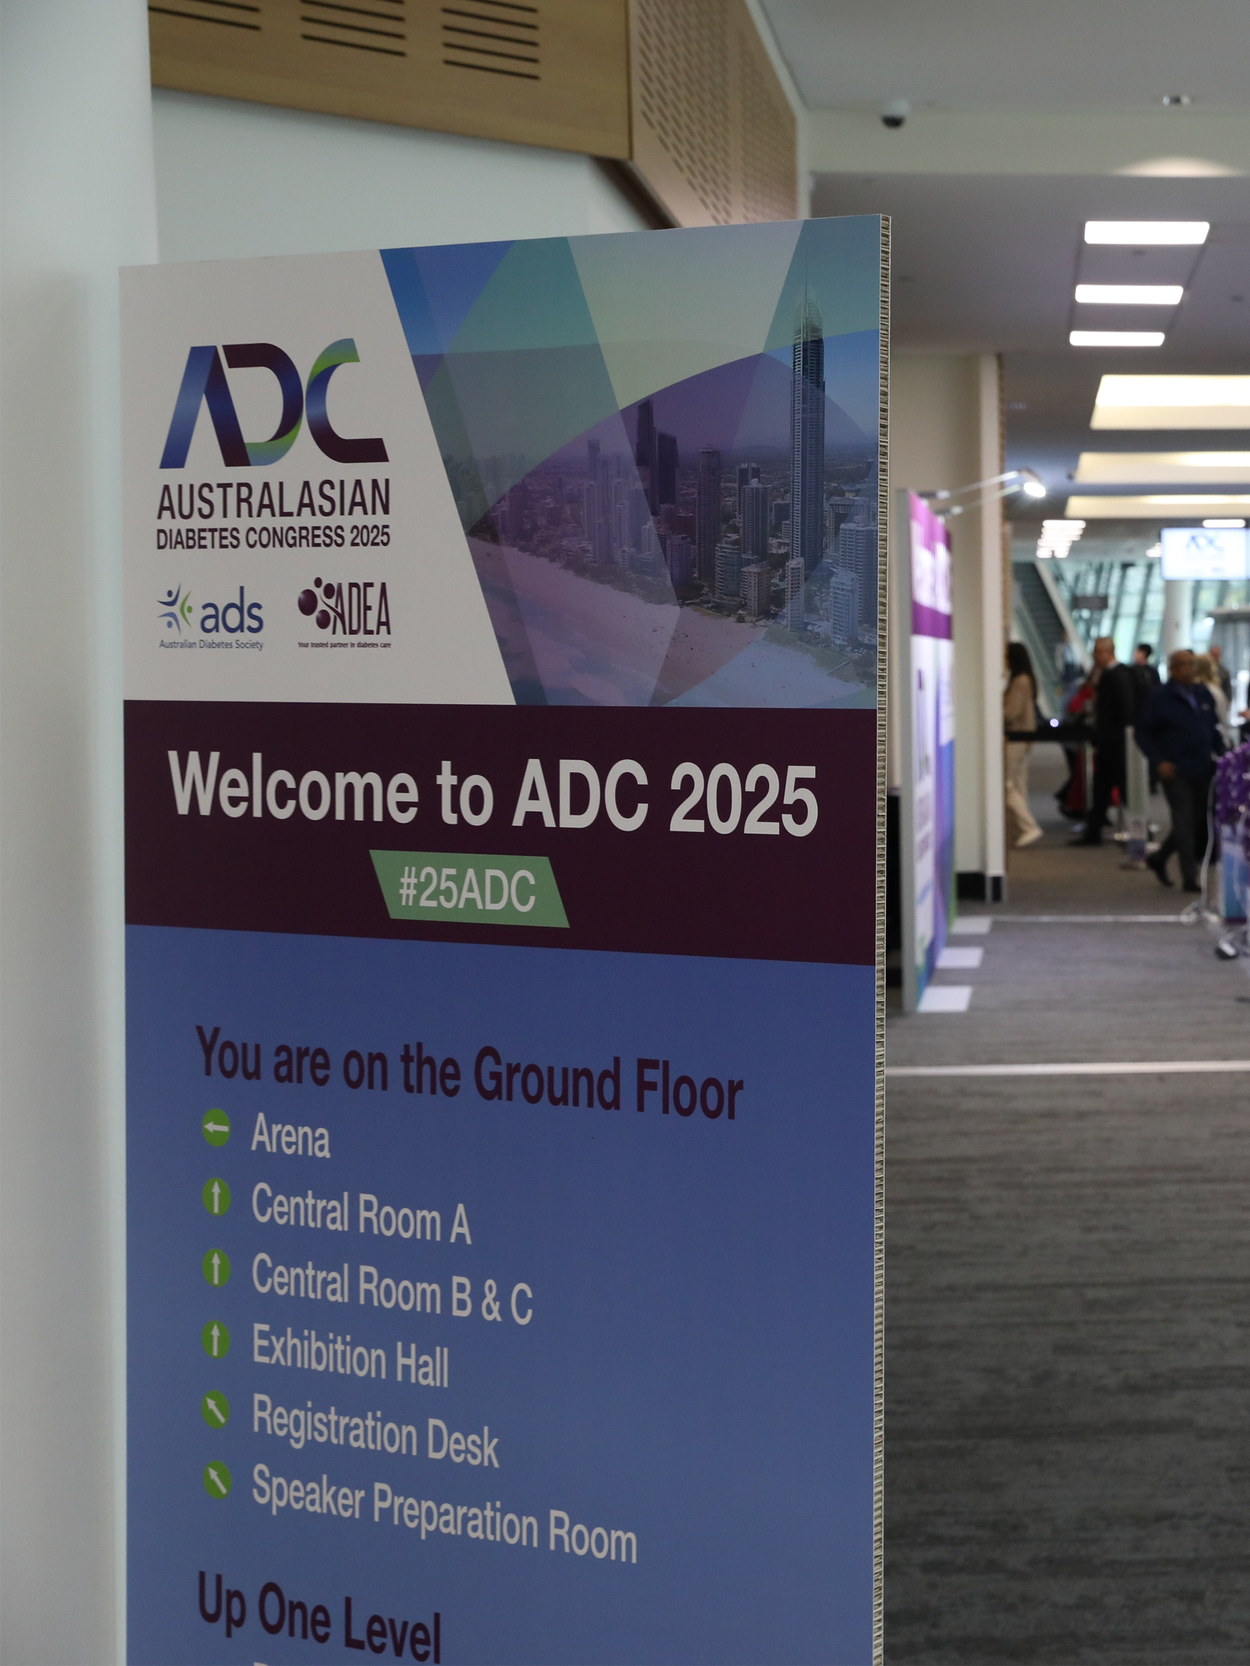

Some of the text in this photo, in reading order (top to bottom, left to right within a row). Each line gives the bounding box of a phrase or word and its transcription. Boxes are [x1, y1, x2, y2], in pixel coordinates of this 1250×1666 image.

[160, 338, 389, 469] ADC
[157, 478, 389, 520] AUSTRALASIAN
[157, 525, 390, 549] DIABETES CONGRESS 2025
[200, 586, 263, 633] ads
[329, 582, 391, 635] ADEA
[160, 639, 264, 652] Australian Diabetes Society
[356, 641, 379, 649] diabetes
[168, 751, 818, 837] Welcome to ADC 2025
[399, 867, 535, 912] #25ADC
[196, 1025, 744, 1120] You are on the Ground Floor
[251, 1113, 330, 1158] Arena
[252, 1182, 471, 1244] Central Room A
[253, 1253, 532, 1325] Central Room B & C
[254, 1323, 448, 1387] Exhibition Hall
[254, 1393, 499, 1468] Registration Desk
[253, 1464, 636, 1563] Speaker Preparation Room
[199, 1571, 440, 1664] Up One Level
